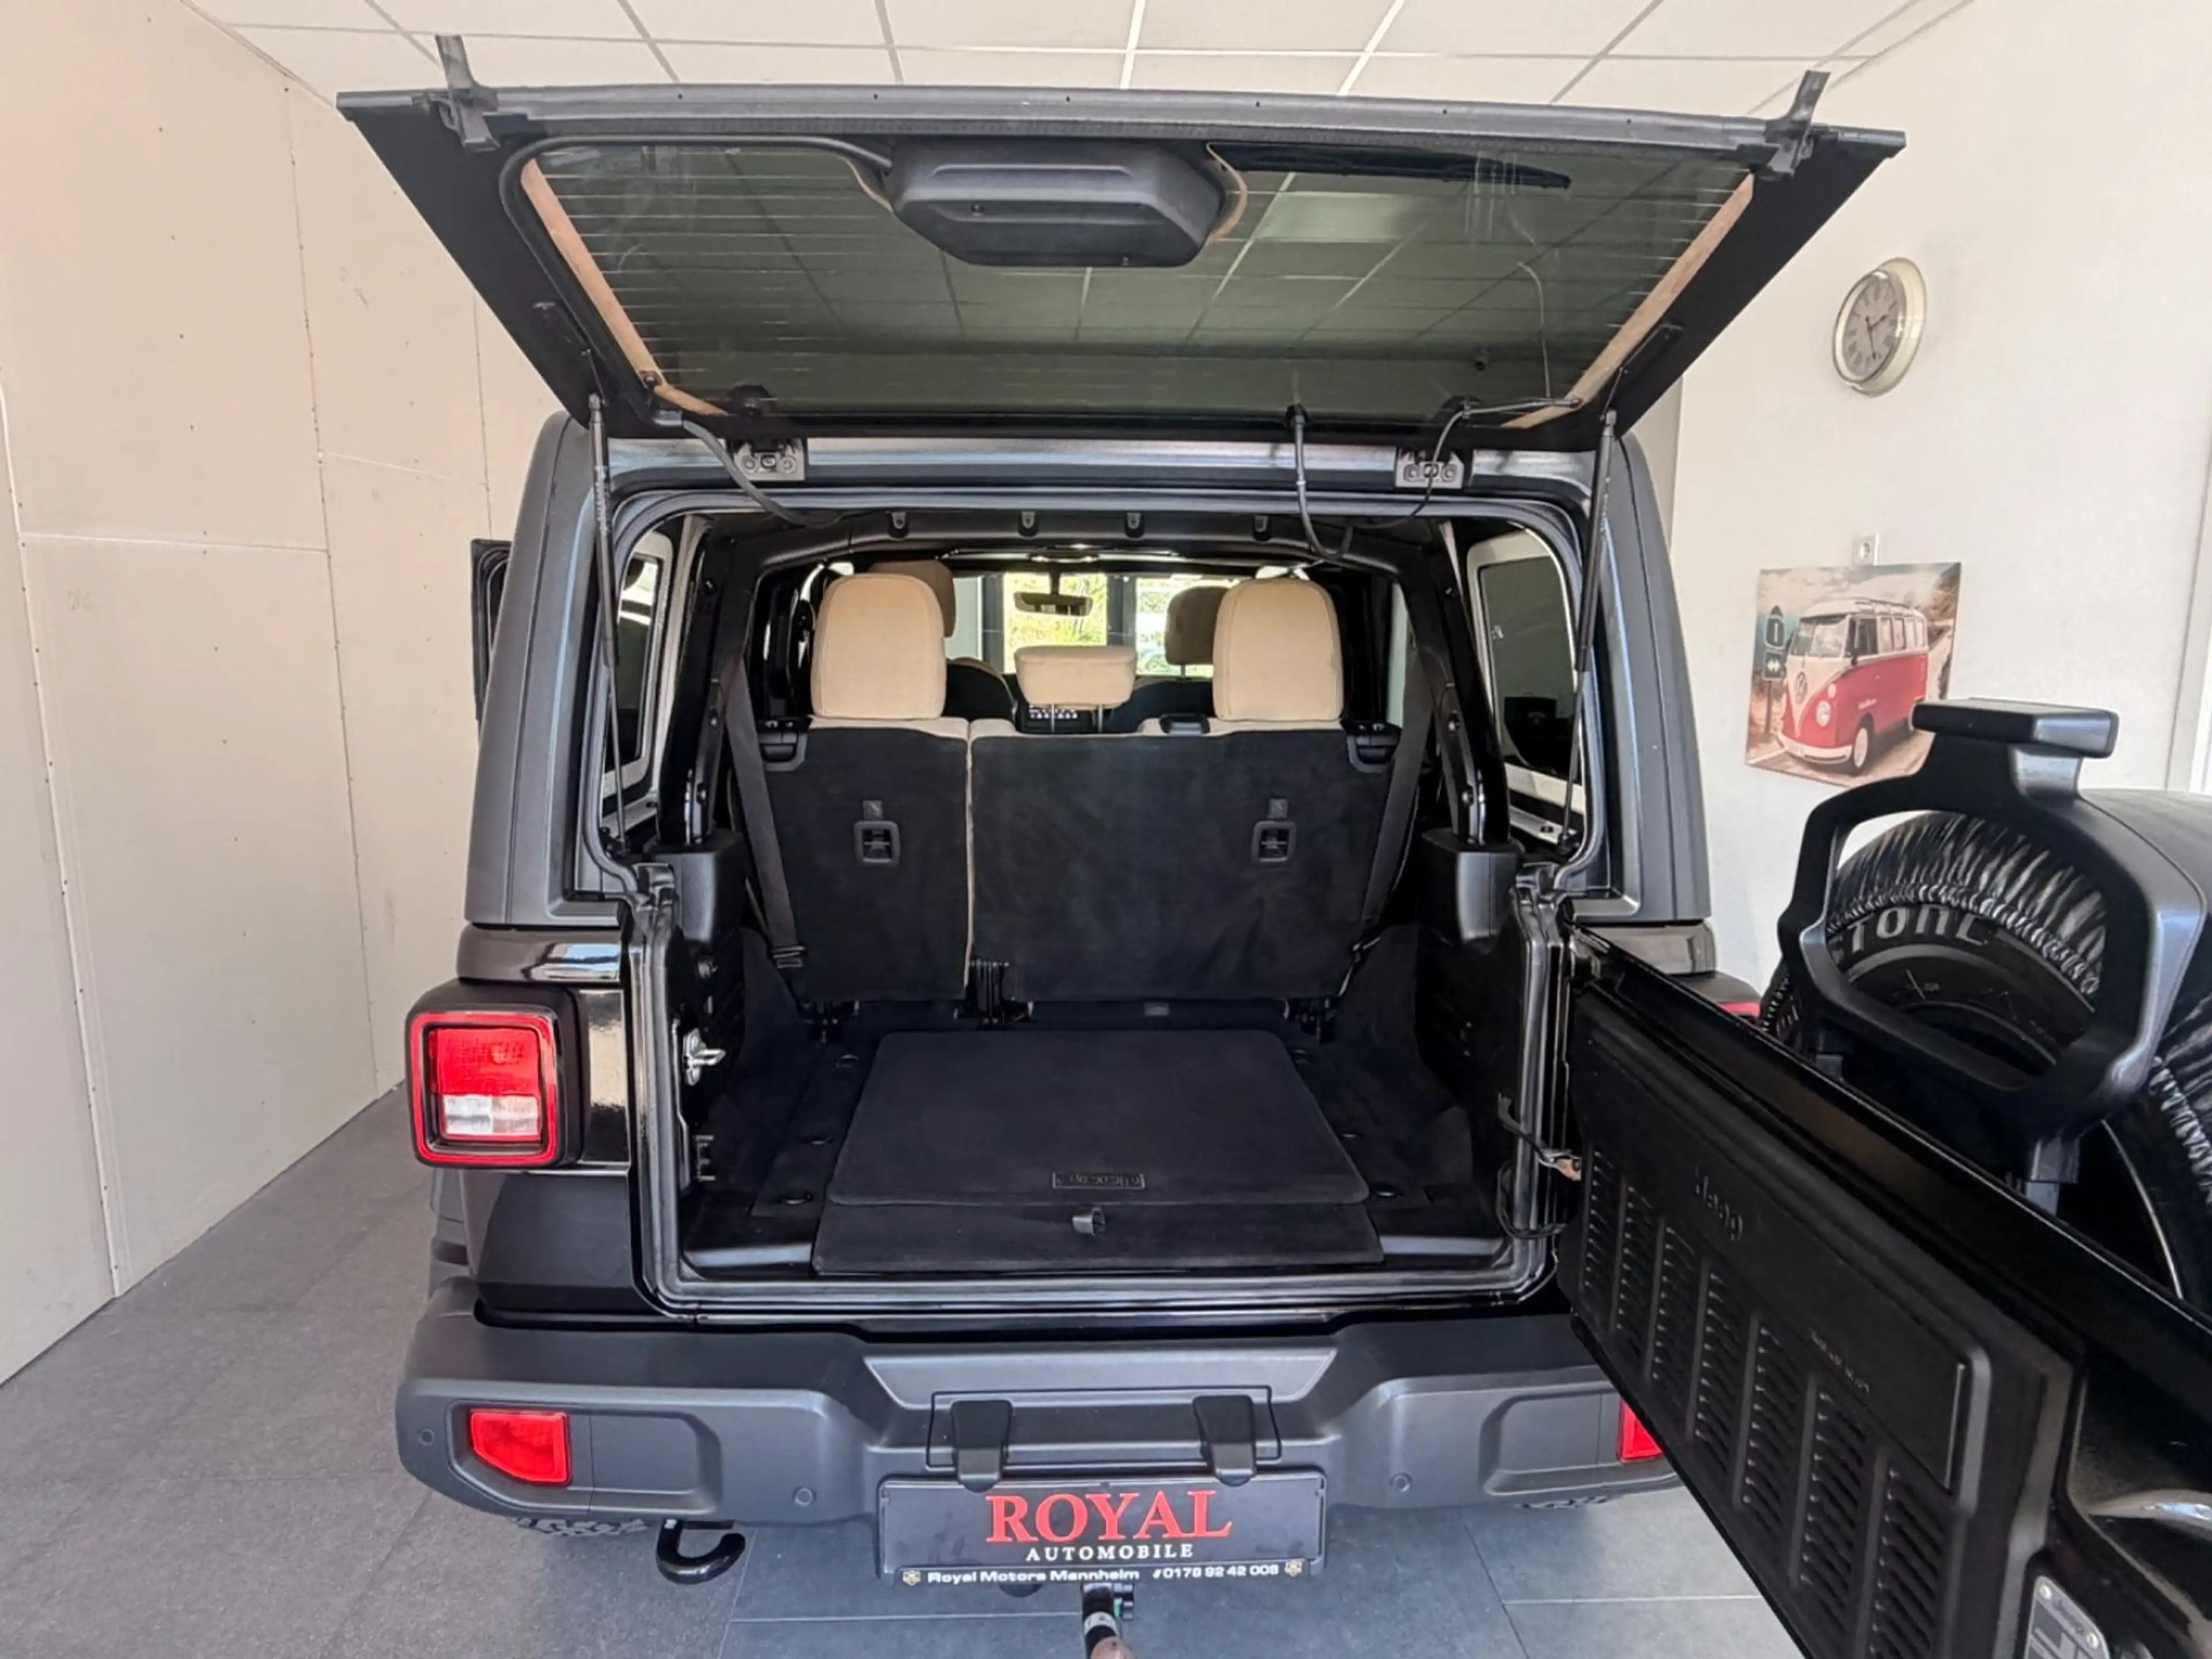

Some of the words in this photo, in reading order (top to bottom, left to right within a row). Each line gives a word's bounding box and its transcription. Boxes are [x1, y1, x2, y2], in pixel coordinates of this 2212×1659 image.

[986, 1491, 1233, 1543] ROYAL
[1026, 1544, 1194, 1562] AUTOMOBILE
[927, 1571, 977, 1585] Royal
[980, 1570, 1046, 1582] Motors
[1050, 1568, 1140, 1581] Mannheim
